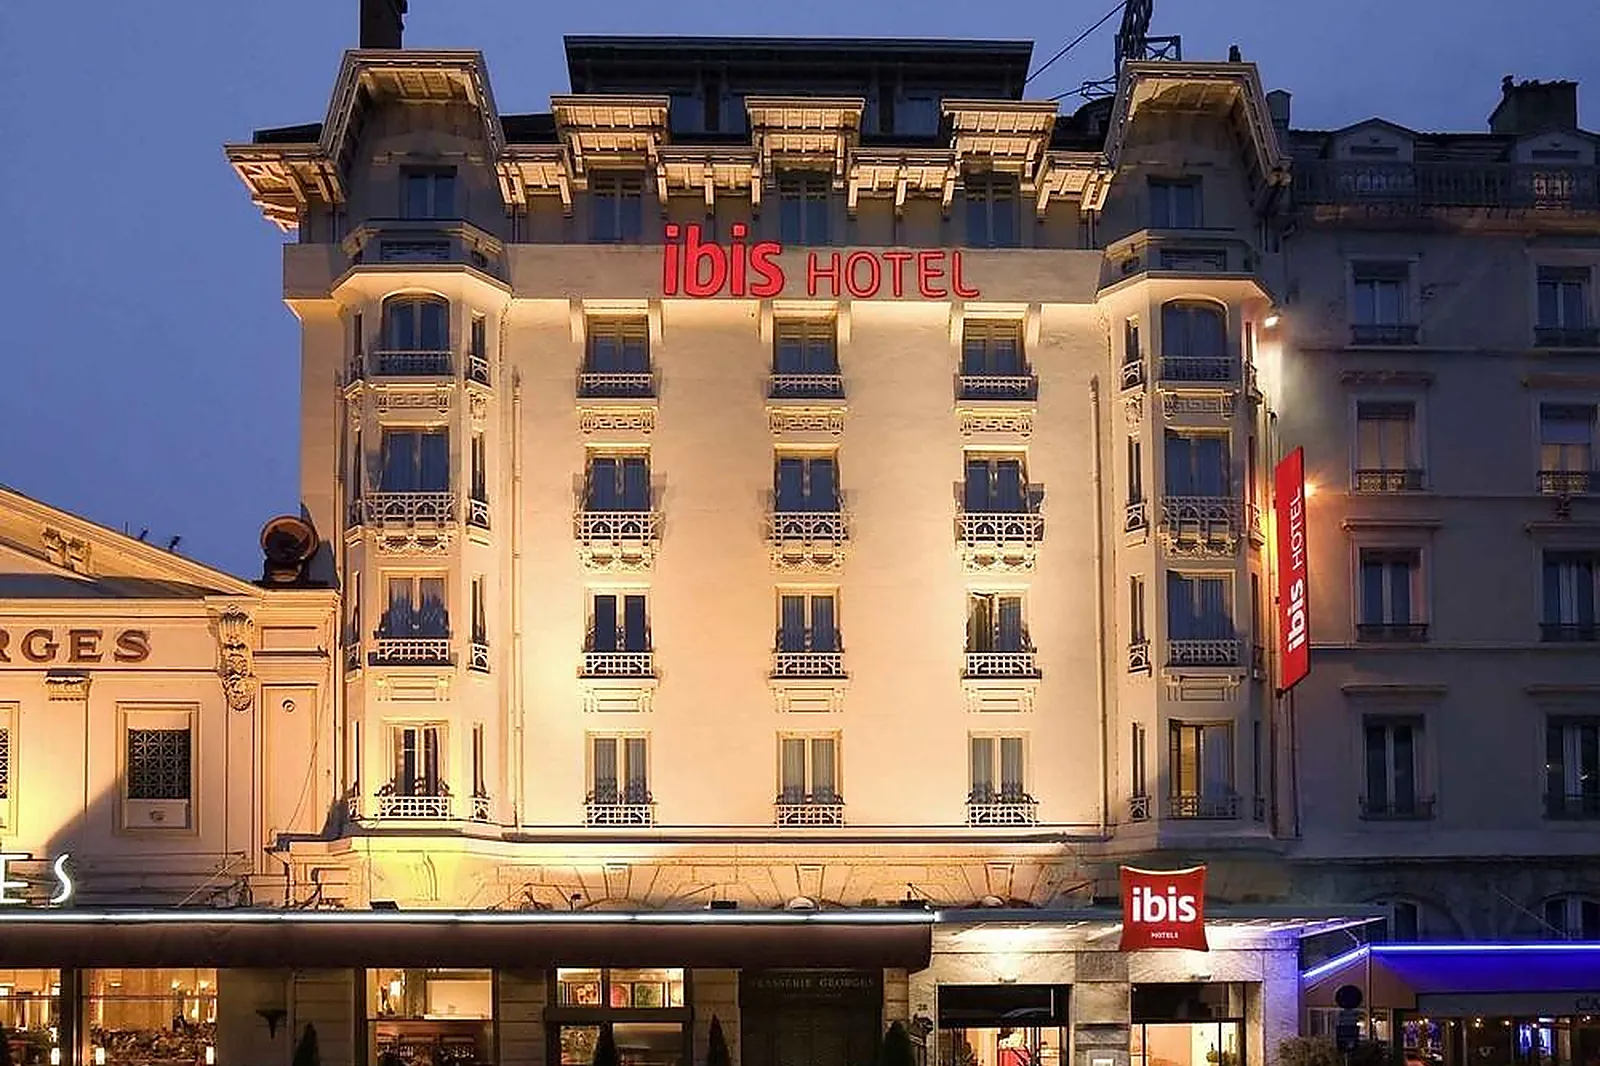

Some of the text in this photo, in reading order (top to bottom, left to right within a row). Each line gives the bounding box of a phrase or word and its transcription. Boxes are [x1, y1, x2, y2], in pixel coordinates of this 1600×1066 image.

[663, 224, 980, 298] ibis HOTEL
[1288, 486, 1306, 653] ibis HOTEL
[0, 853, 73, 904] ES
[1132, 886, 1197, 923] ibis
[1150, 931, 1179, 939] HOTELS
